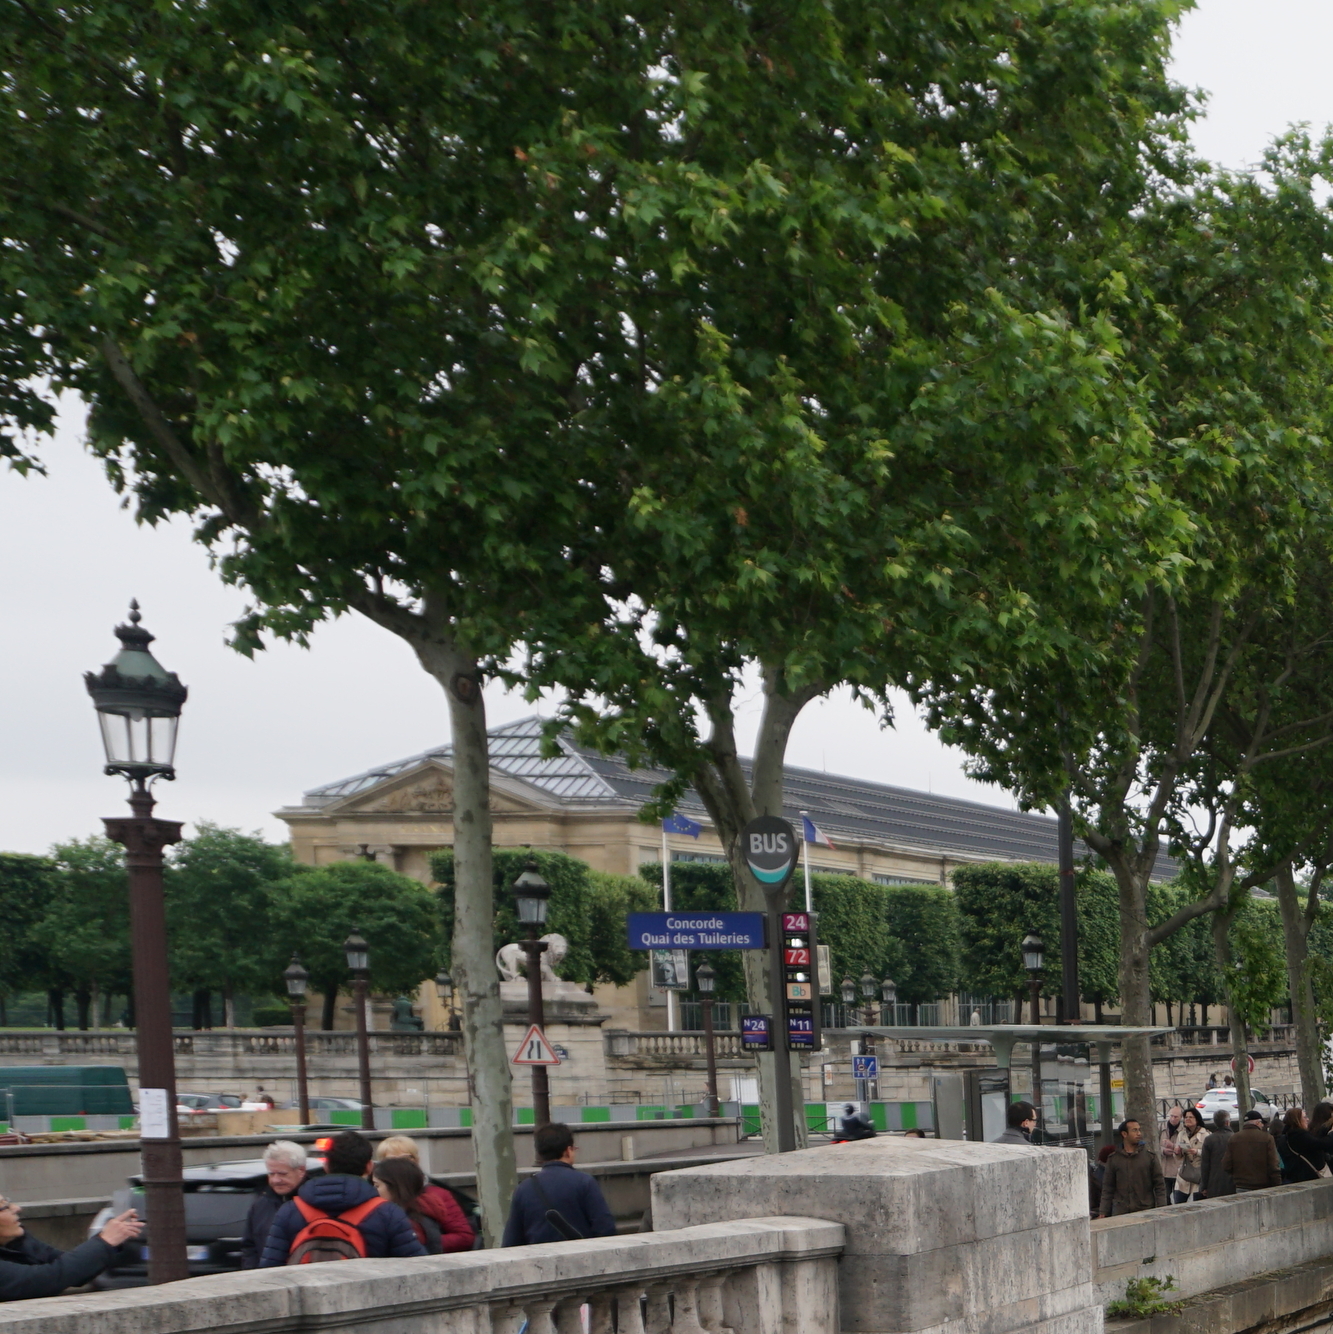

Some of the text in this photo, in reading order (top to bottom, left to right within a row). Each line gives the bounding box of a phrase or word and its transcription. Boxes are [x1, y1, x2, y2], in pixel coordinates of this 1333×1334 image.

[750, 833, 787, 853] BUS
[666, 917, 724, 929] Concorde
[786, 915, 806, 929] 24
[641, 932, 750, 945] Quai des Tuileries
[788, 949, 807, 963] 72
[792, 985, 806, 997] Bb
